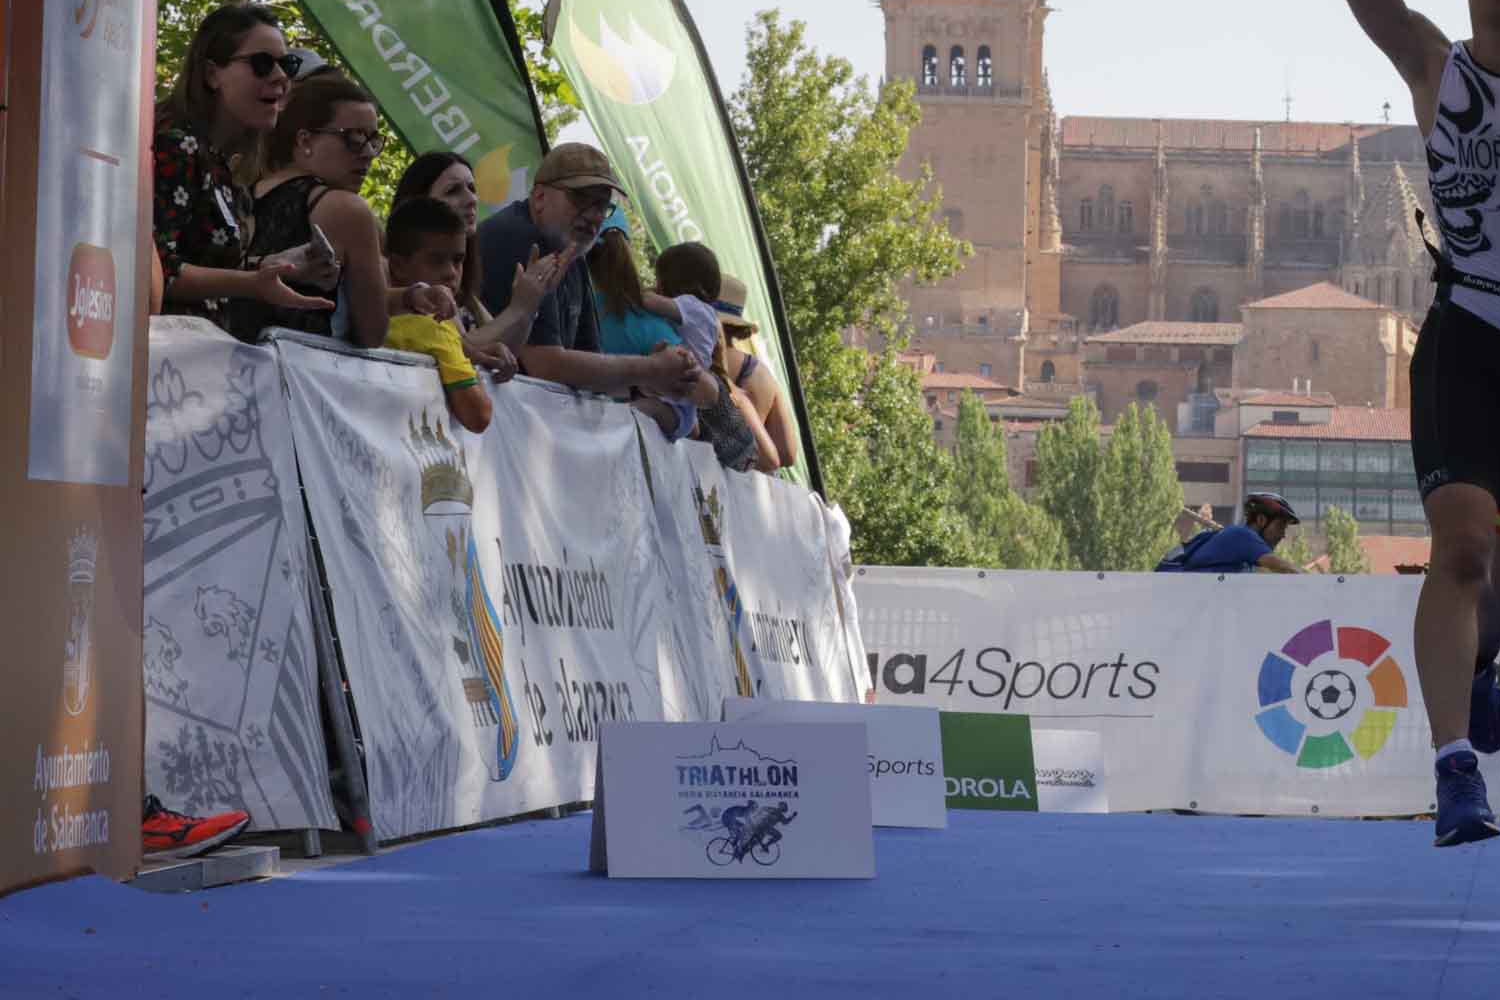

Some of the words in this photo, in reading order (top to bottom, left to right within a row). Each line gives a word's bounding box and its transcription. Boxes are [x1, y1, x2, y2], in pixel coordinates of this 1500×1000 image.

[33, 739, 111, 800] Ayuntamiento
[676, 764, 799, 787] TRIATHLON
[33, 806, 49, 854] de
[50, 801, 110, 853] Salamanca
